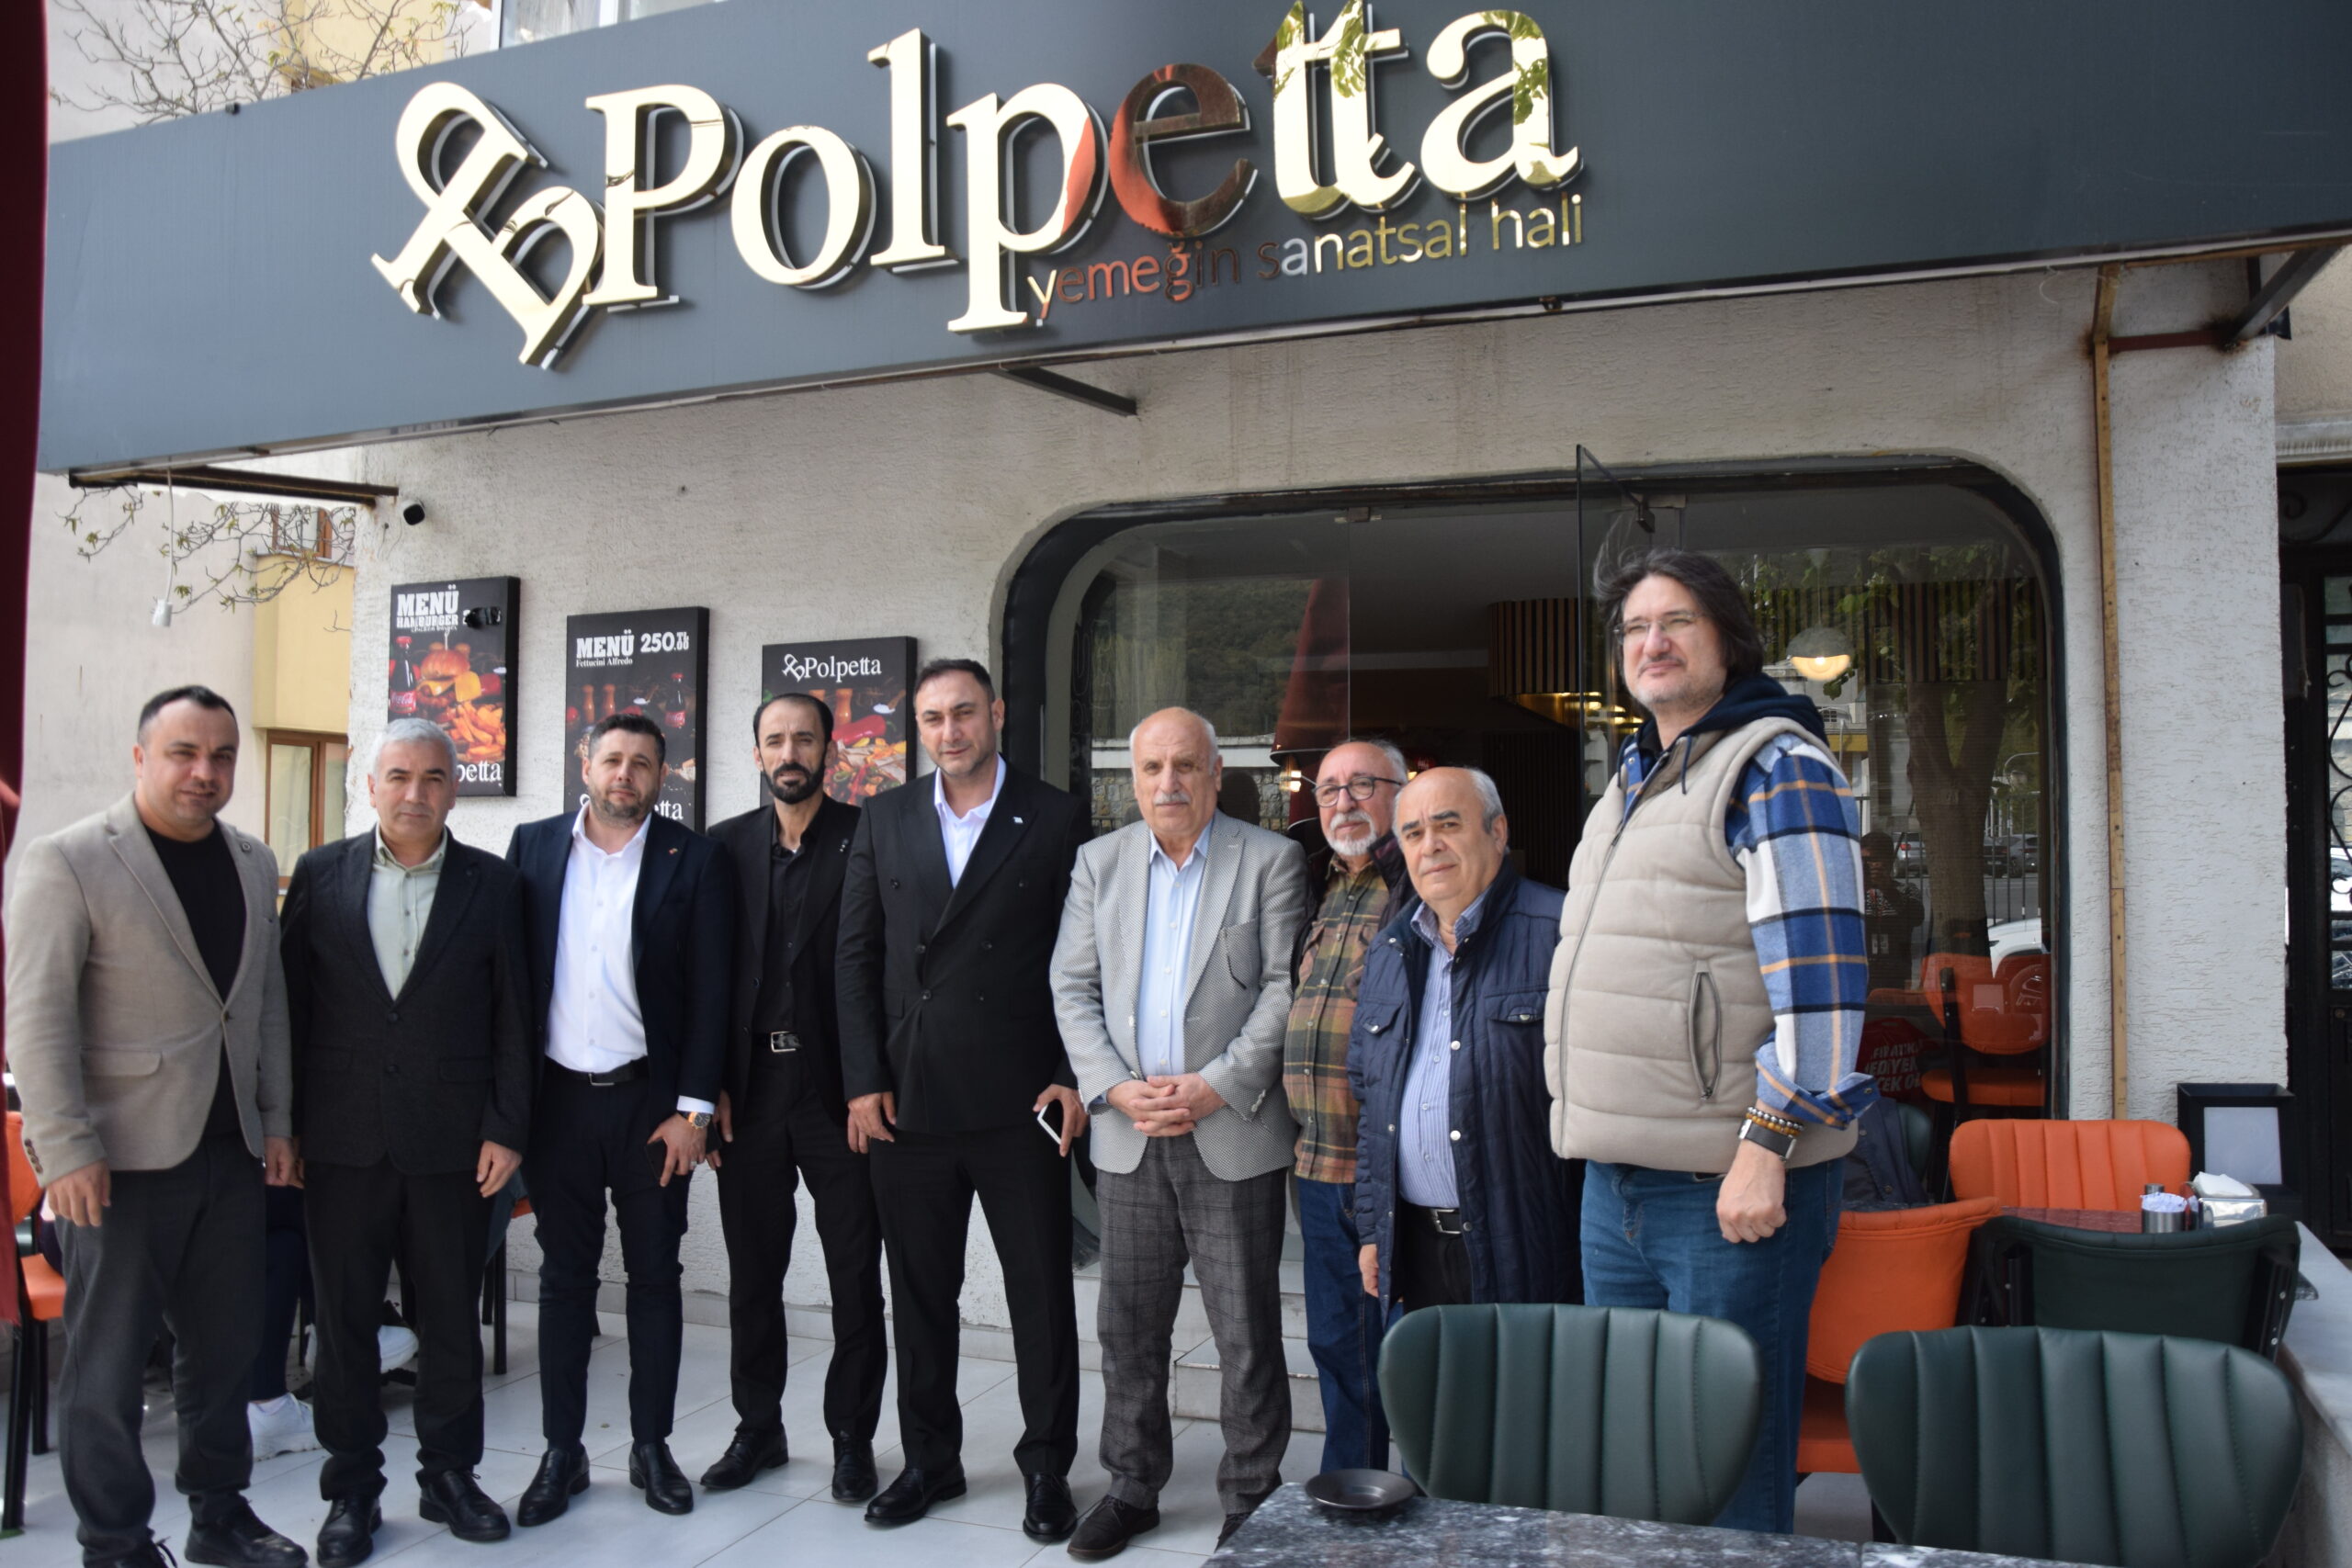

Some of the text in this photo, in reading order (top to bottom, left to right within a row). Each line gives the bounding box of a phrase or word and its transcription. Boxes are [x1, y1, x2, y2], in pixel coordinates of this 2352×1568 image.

[582, 0, 1578, 333] Polpetta
[1027, 192, 1581, 319] yemeğin sanatsal hali
[397, 584, 459, 616] MENÜ
[396, 615, 458, 628] HAMBURGER
[576, 629, 635, 659] MENÜ
[606, 656, 633, 666] Alfredo
[804, 655, 882, 682] Polpetta
